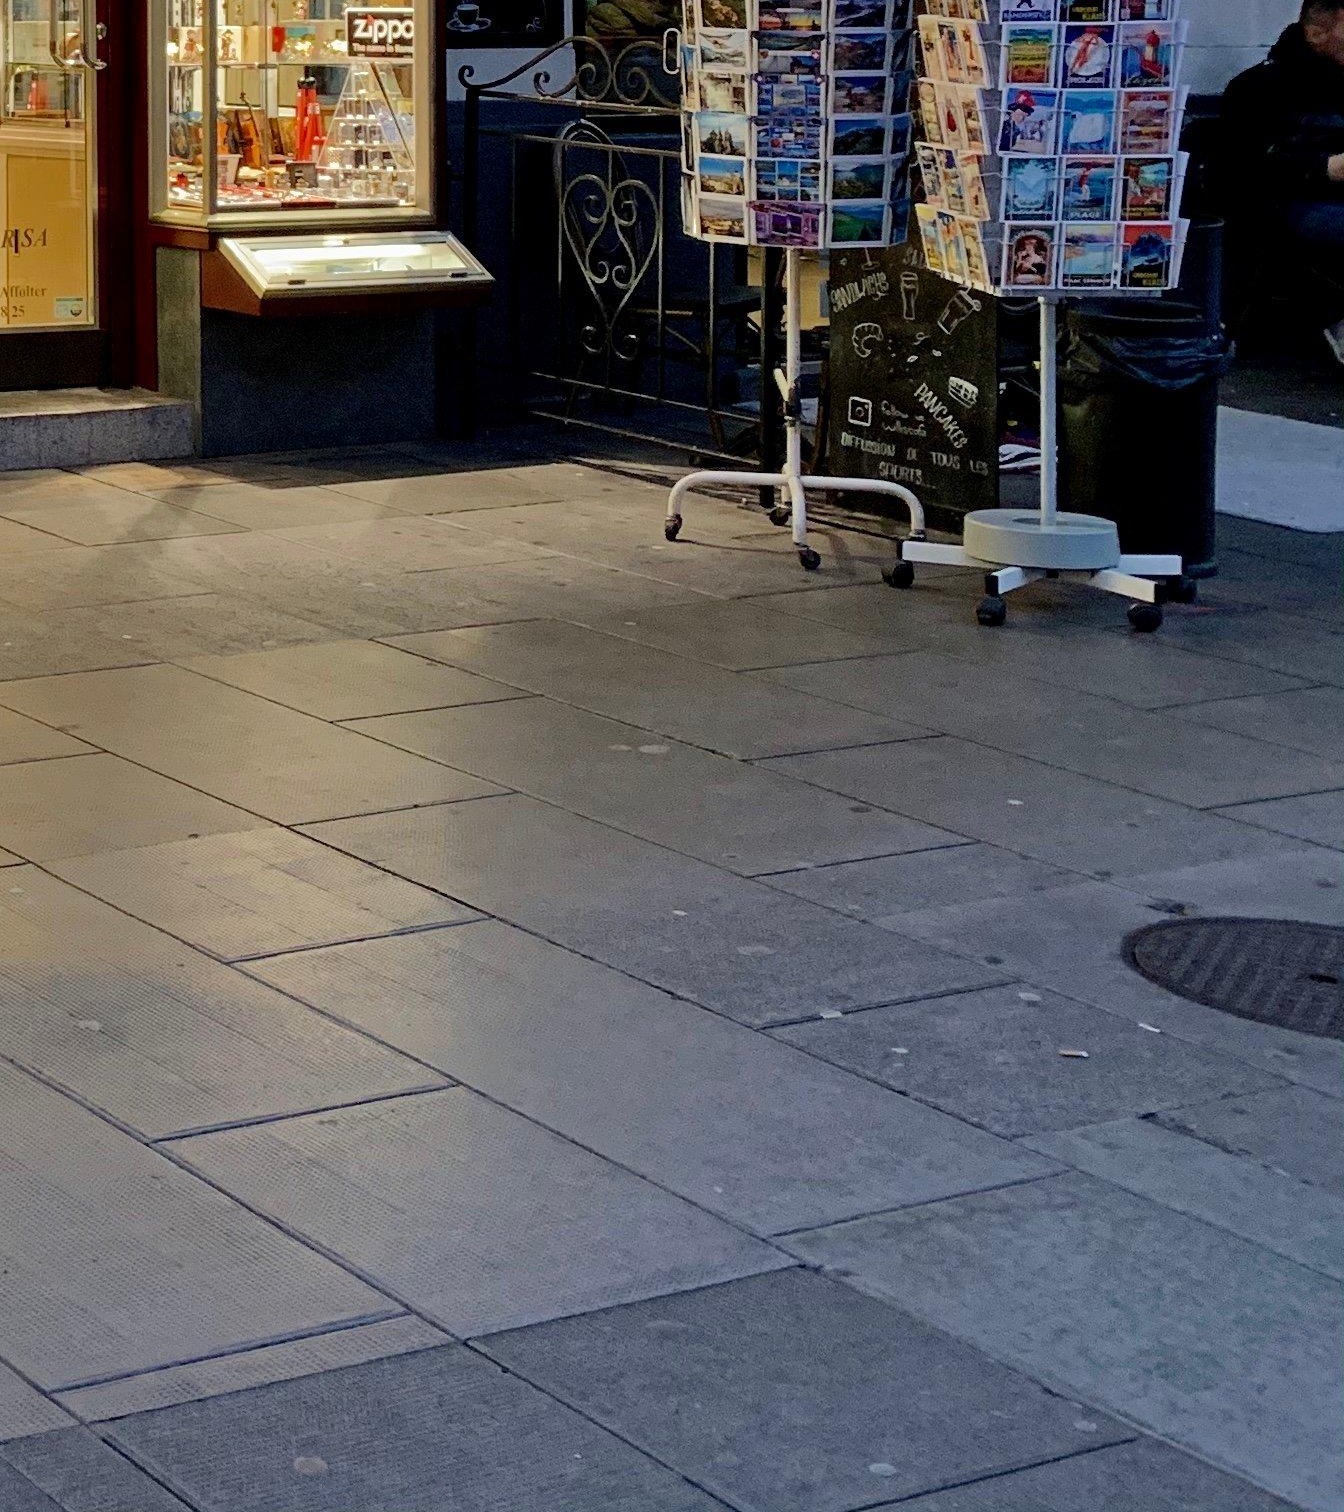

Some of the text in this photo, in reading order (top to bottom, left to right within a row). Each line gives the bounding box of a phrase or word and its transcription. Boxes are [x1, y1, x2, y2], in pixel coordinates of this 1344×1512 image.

[353, 14, 414, 44] zippo
[21, 228, 47, 248] SA
[0, 285, 47, 298] Affolter
[12, 305, 25, 318] 25
[913, 383, 968, 448] PANCAKES
[930, 451, 960, 469] TOUS
